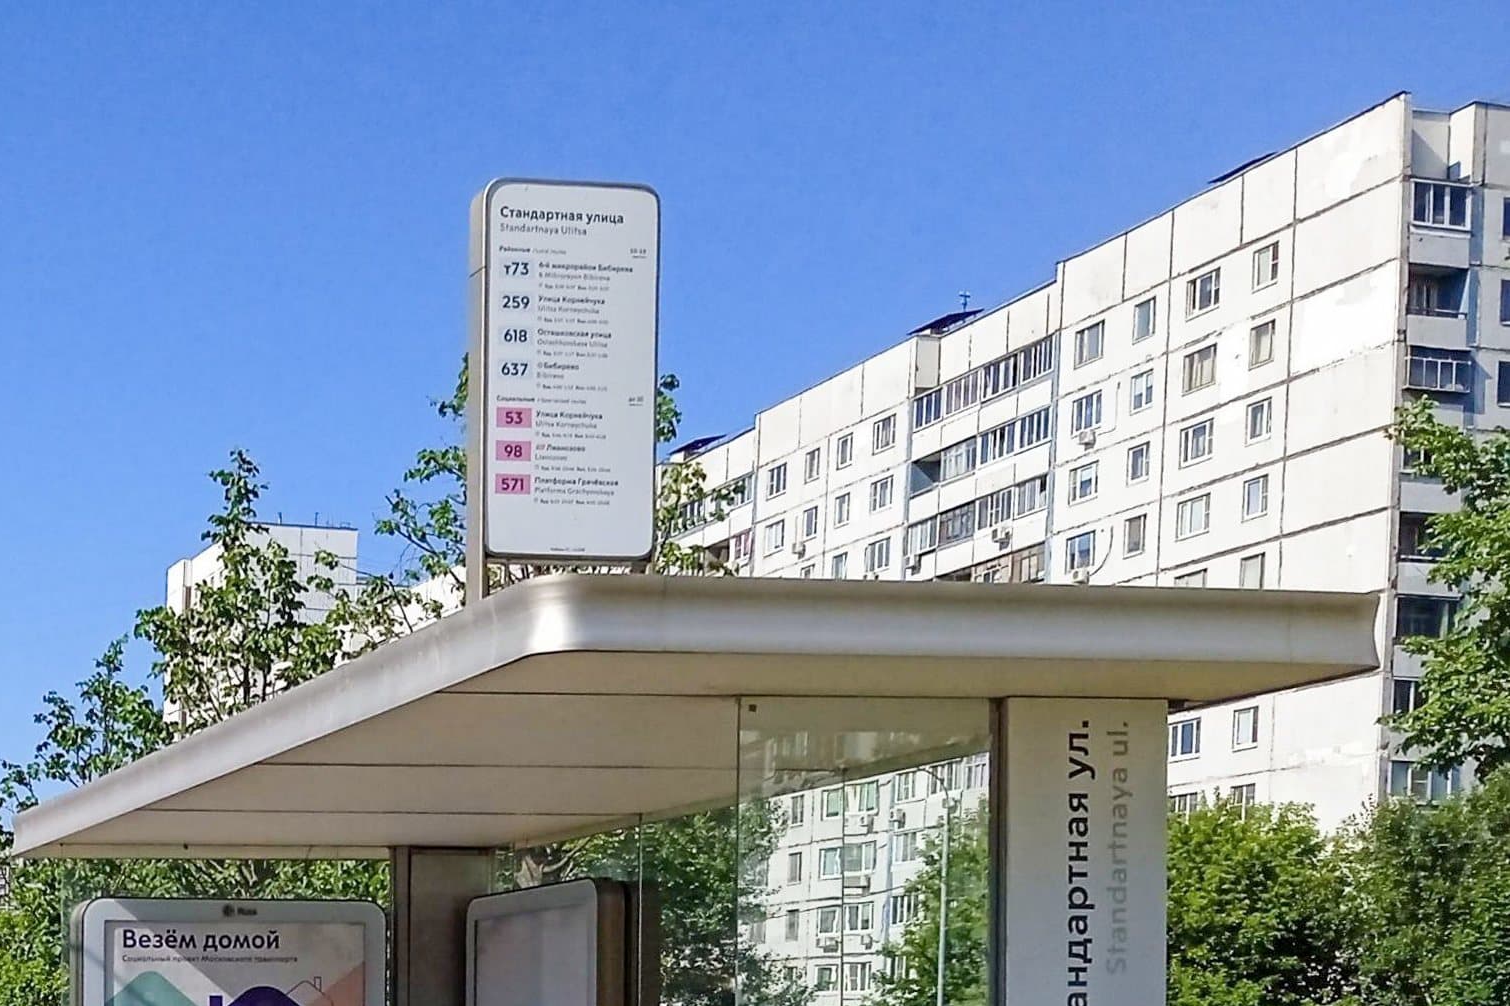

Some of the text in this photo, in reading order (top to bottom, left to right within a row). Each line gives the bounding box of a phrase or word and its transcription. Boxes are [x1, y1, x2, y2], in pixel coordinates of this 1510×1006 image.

[500, 206, 624, 224] Стандартная улица
[500, 223, 587, 236] Standartnaya Ulitsa
[502, 295, 530, 310] 259
[503, 328, 528, 343] 618
[501, 362, 528, 377] 637
[505, 412, 523, 425] 53
[504, 444, 523, 458] 98
[501, 478, 524, 492] 571
[1068, 719, 1095, 779] ул.
[1106, 719, 1134, 976] Standartnaya ul.
[122, 929, 280, 952] Везём домой
